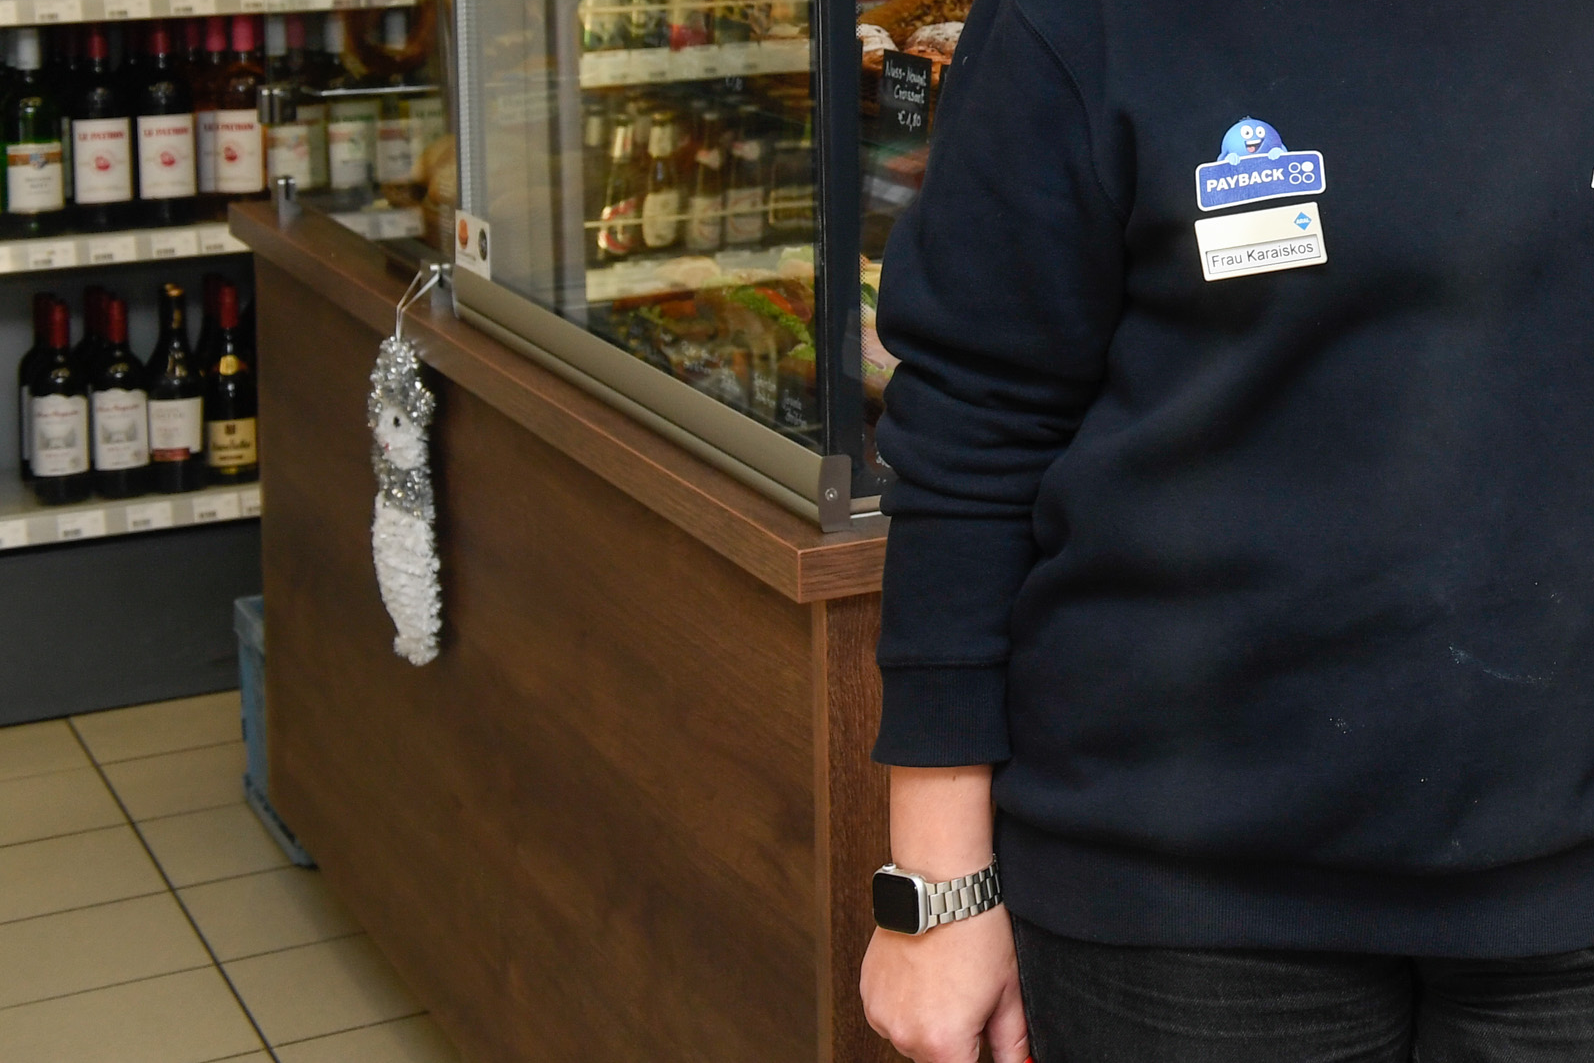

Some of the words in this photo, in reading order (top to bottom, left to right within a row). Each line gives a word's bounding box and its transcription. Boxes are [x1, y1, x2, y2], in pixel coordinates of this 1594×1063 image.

[1207, 168, 1284, 192] PAYBACK
[1212, 254, 1243, 268] Frau
[1246, 242, 1313, 263] Karaiskos
